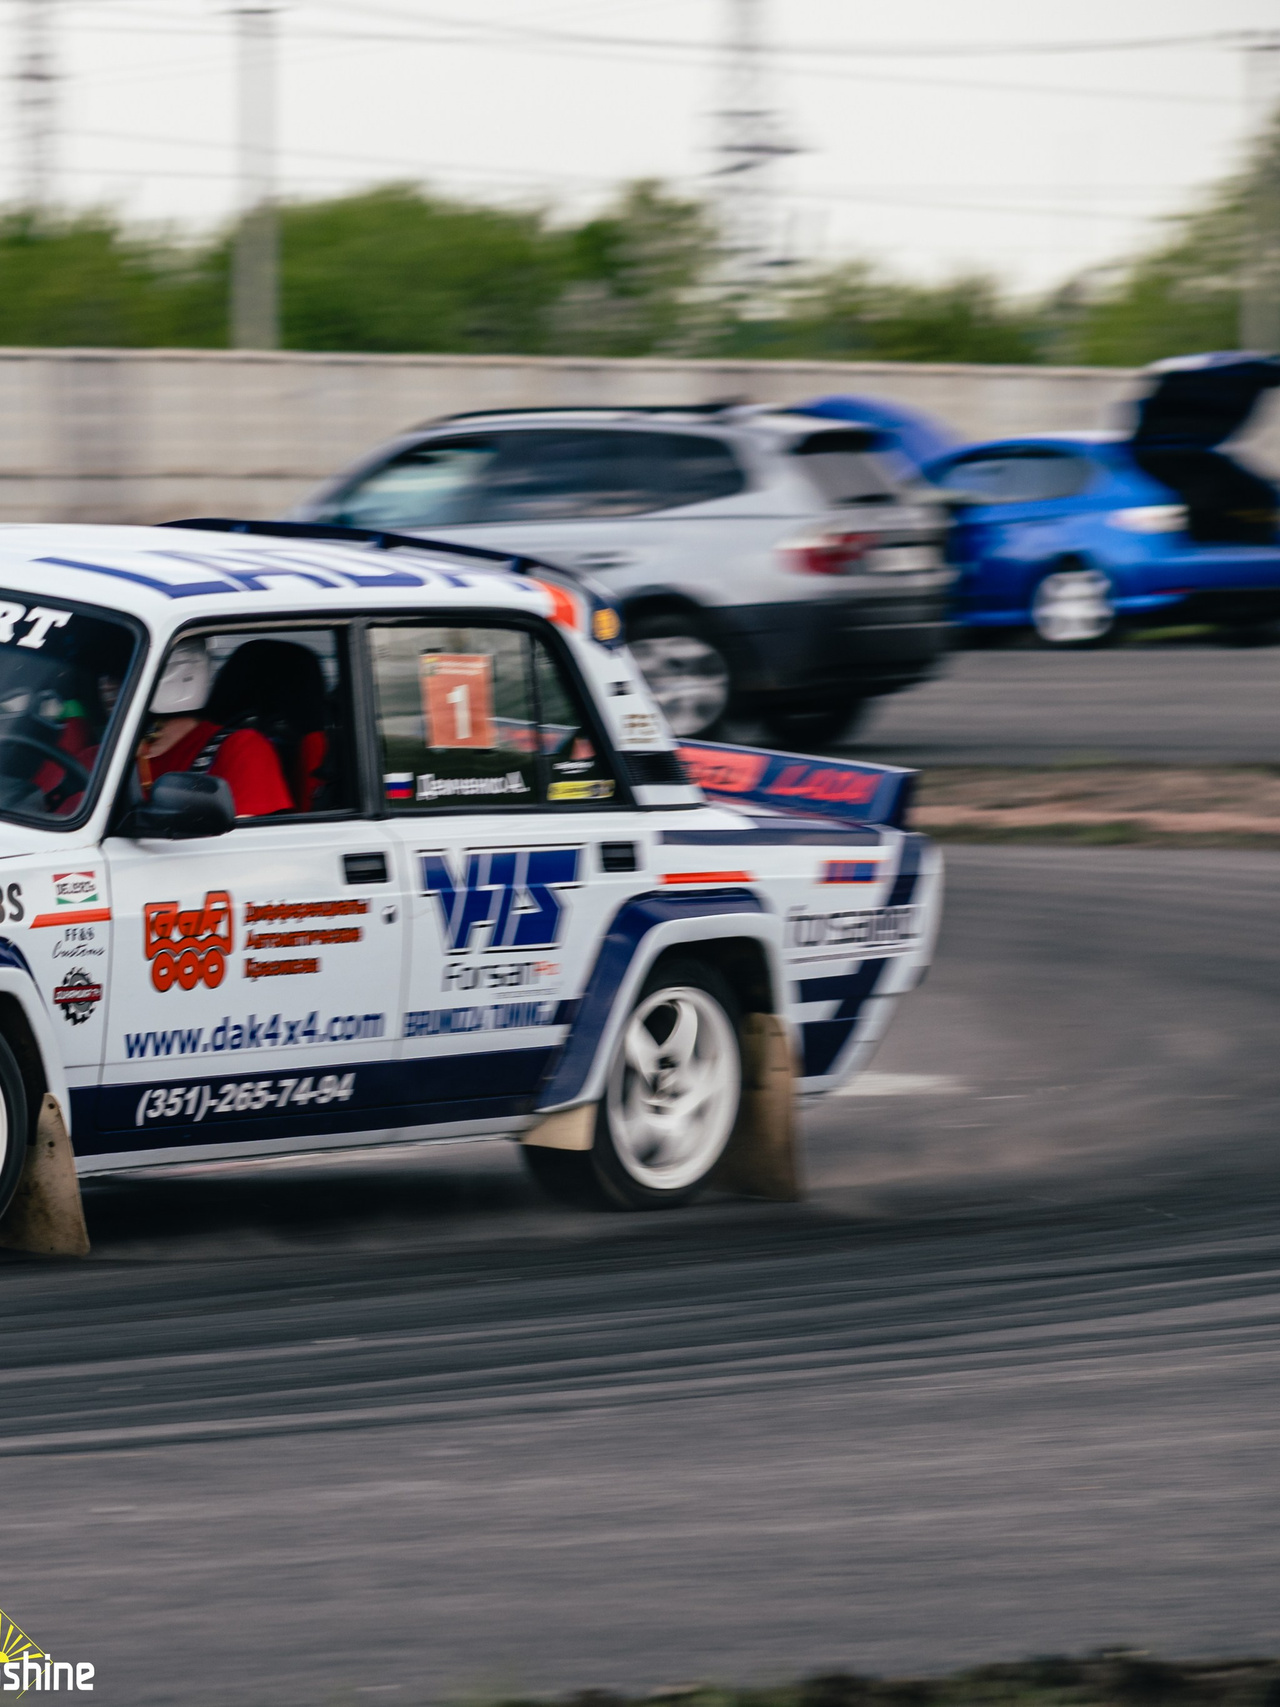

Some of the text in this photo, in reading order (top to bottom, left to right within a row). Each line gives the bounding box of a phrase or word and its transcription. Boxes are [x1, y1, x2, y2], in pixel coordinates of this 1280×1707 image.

[446, 684, 473, 739] 1
[124, 1011, 385, 1059] www.dak4x4.com
[136, 1072, 357, 1126] (351)-265-74-94
